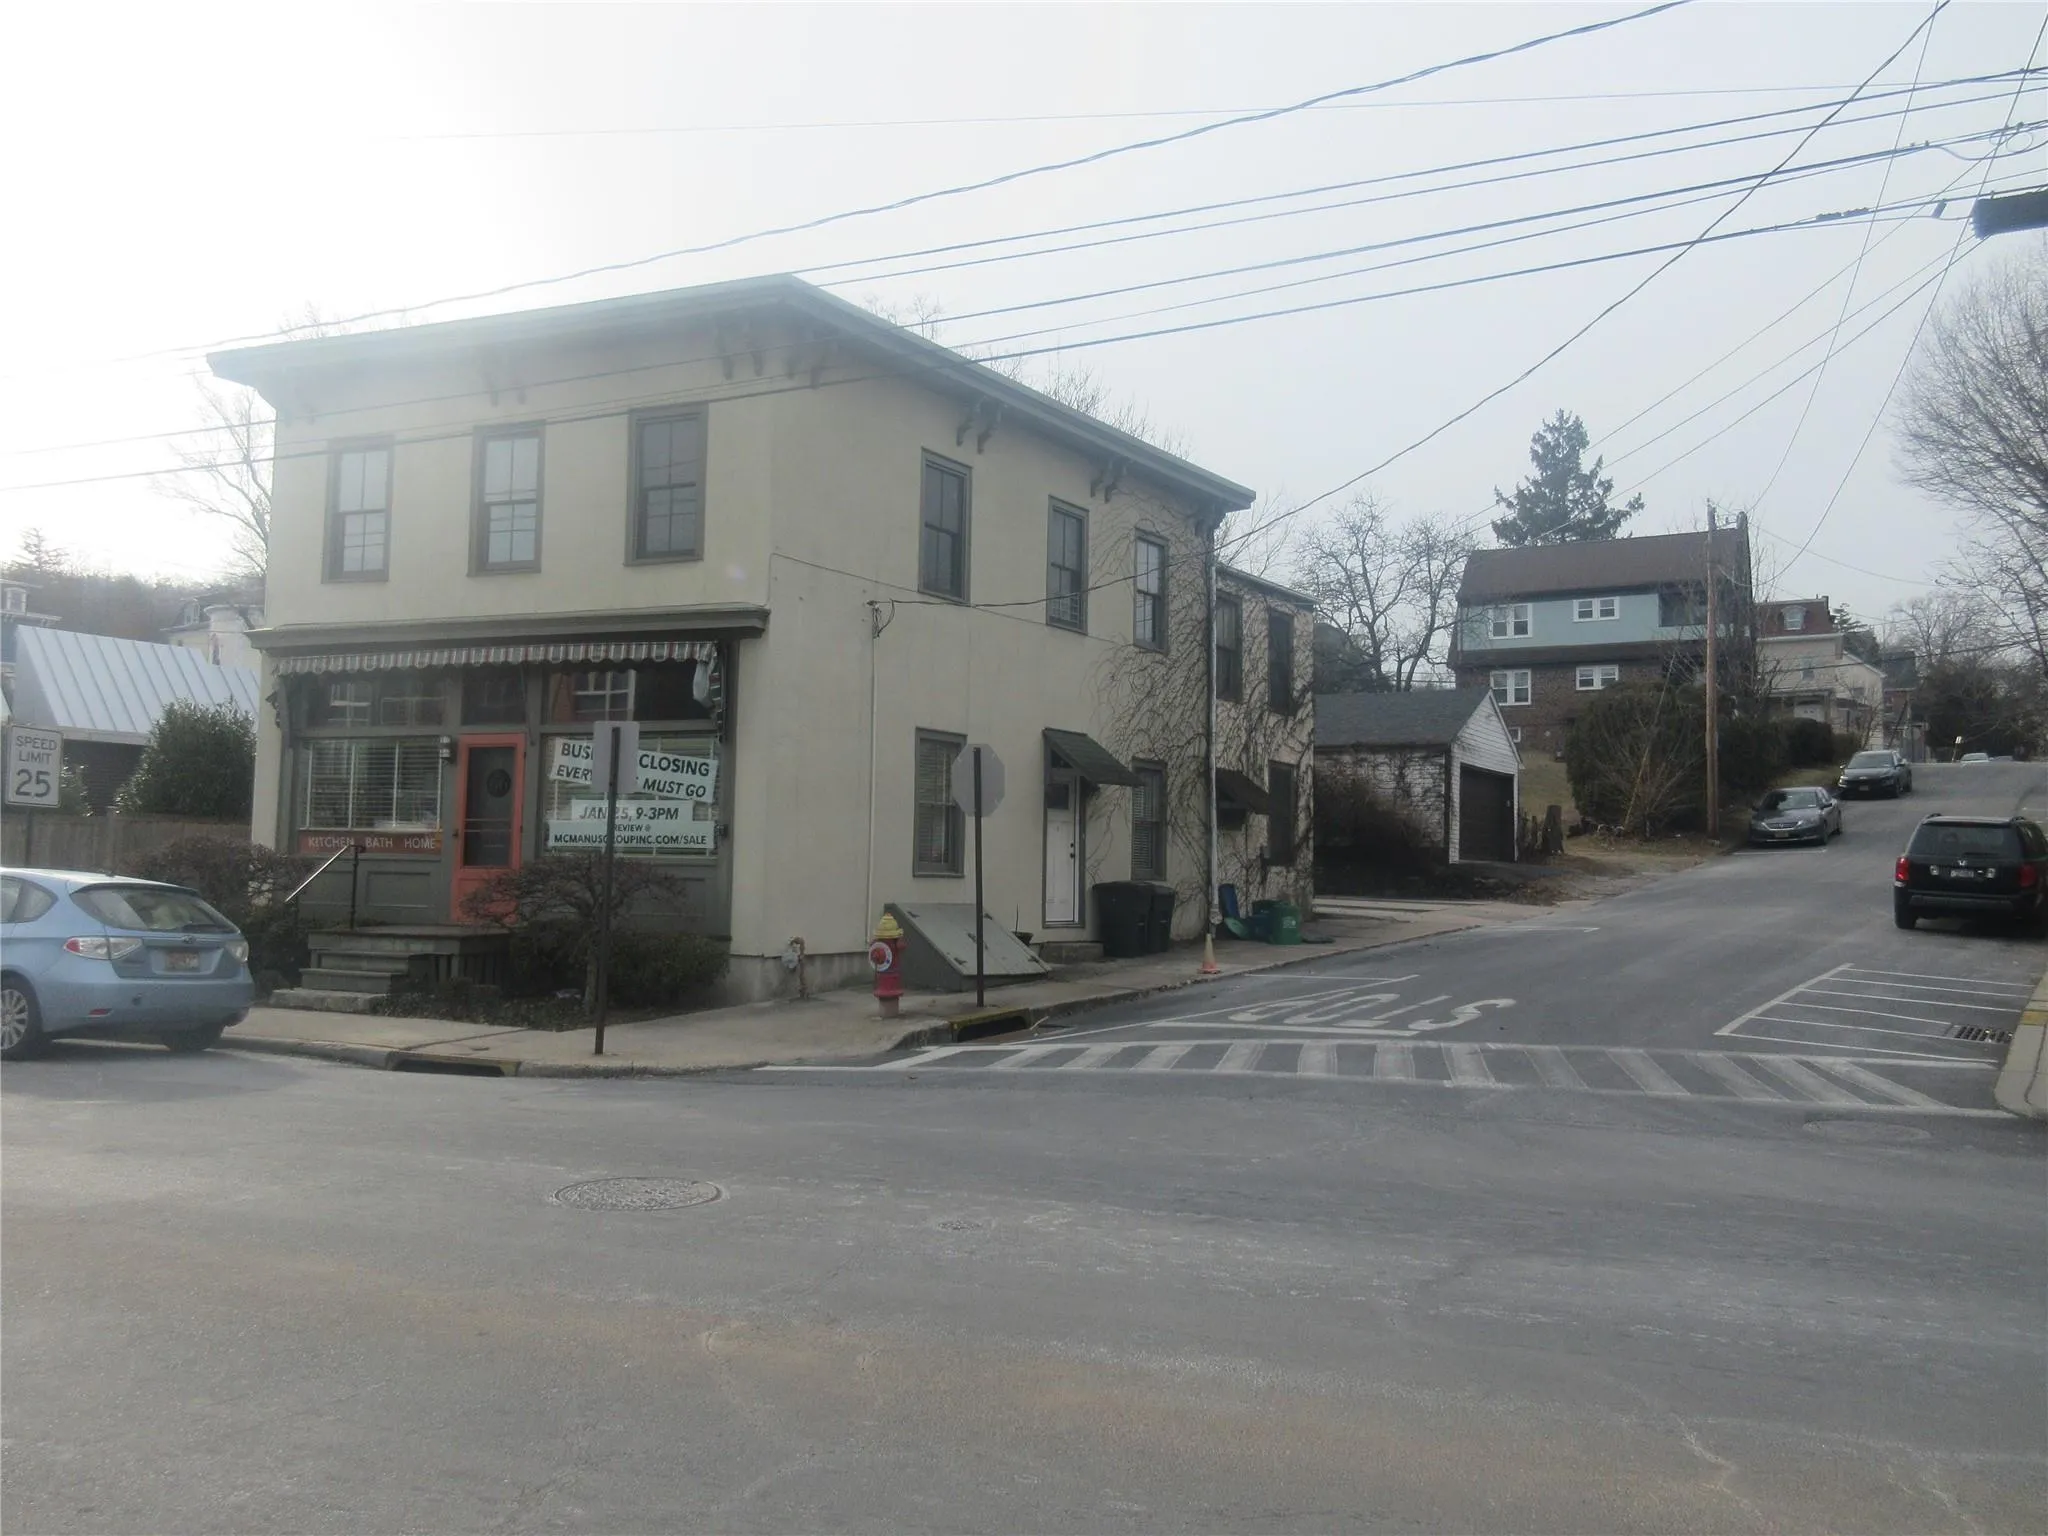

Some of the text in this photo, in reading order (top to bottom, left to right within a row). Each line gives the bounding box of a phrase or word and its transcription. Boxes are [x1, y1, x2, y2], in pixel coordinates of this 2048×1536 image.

[16, 735, 57, 750] SPEED
[19, 750, 52, 764] LIMIT
[638, 753, 710, 776] CLOSING
[16, 769, 51, 797] 25
[642, 778, 683, 795] MUST
[685, 785, 706, 798] GO
[580, 806, 607, 820] JAN
[635, 807, 679, 820] 9-3PM
[612, 823, 644, 832] REVIEW
[308, 837, 436, 849] KITCHEN BATH HOME
[554, 833, 707, 845] MCMANUSGOUPINC.COM/SALE
[1229, 992, 1516, 1031] STOP
